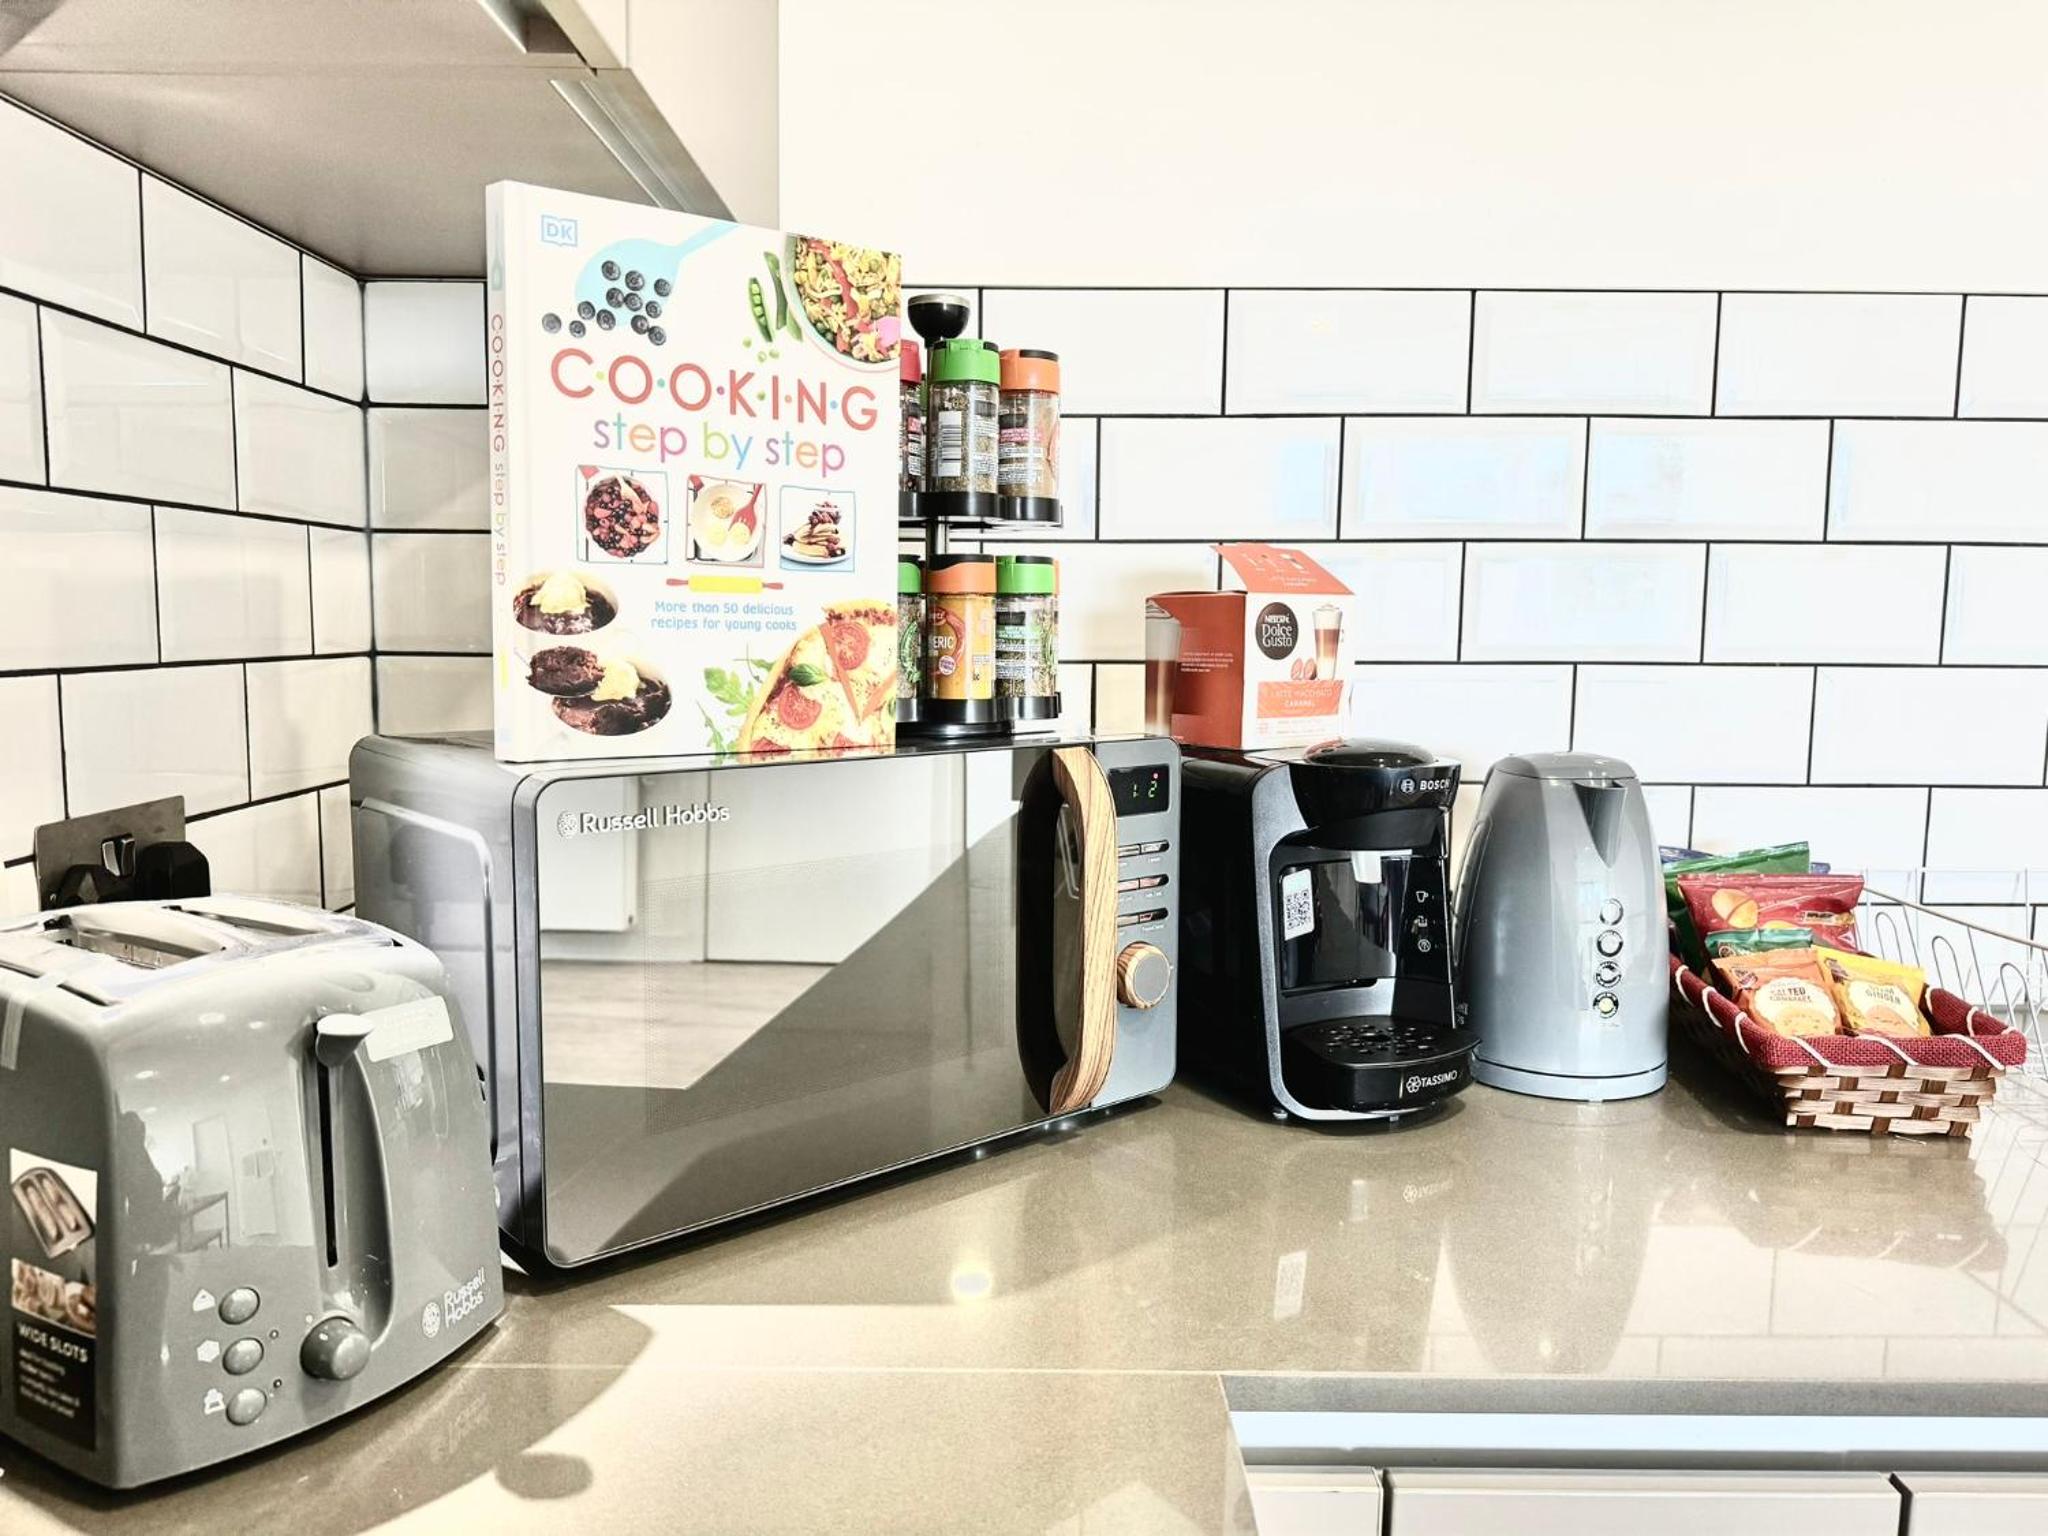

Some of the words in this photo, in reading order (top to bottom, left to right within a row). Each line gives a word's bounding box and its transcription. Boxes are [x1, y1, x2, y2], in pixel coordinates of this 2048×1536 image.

[546, 220, 574, 241] DK
[593, 412, 688, 463] step
[703, 421, 753, 471] by
[765, 430, 846, 478] step
[493, 462, 506, 507] step
[493, 512, 505, 538] by
[495, 542, 507, 587] step
[654, 601, 688, 613] More
[692, 601, 720, 614] than
[723, 602, 739, 615] 50
[742, 602, 795, 616] delicious
[650, 616, 699, 631] recipes
[702, 617, 721, 630] for
[724, 619, 762, 632] young
[765, 619, 798, 631] cooks
[1262, 623, 1293, 638] Dolce
[1262, 635, 1293, 648] Gusto
[1419, 778, 1450, 791] BOSCH
[580, 807, 659, 834] Russell
[664, 802, 731, 826] Hobbs
[1421, 1070, 1458, 1088] TASSIMO
[444, 1266, 486, 1308] Russell
[444, 1290, 484, 1329] Hobbs
[17, 1321, 48, 1348] WIDE
[49, 1335, 89, 1364] SLOTS
